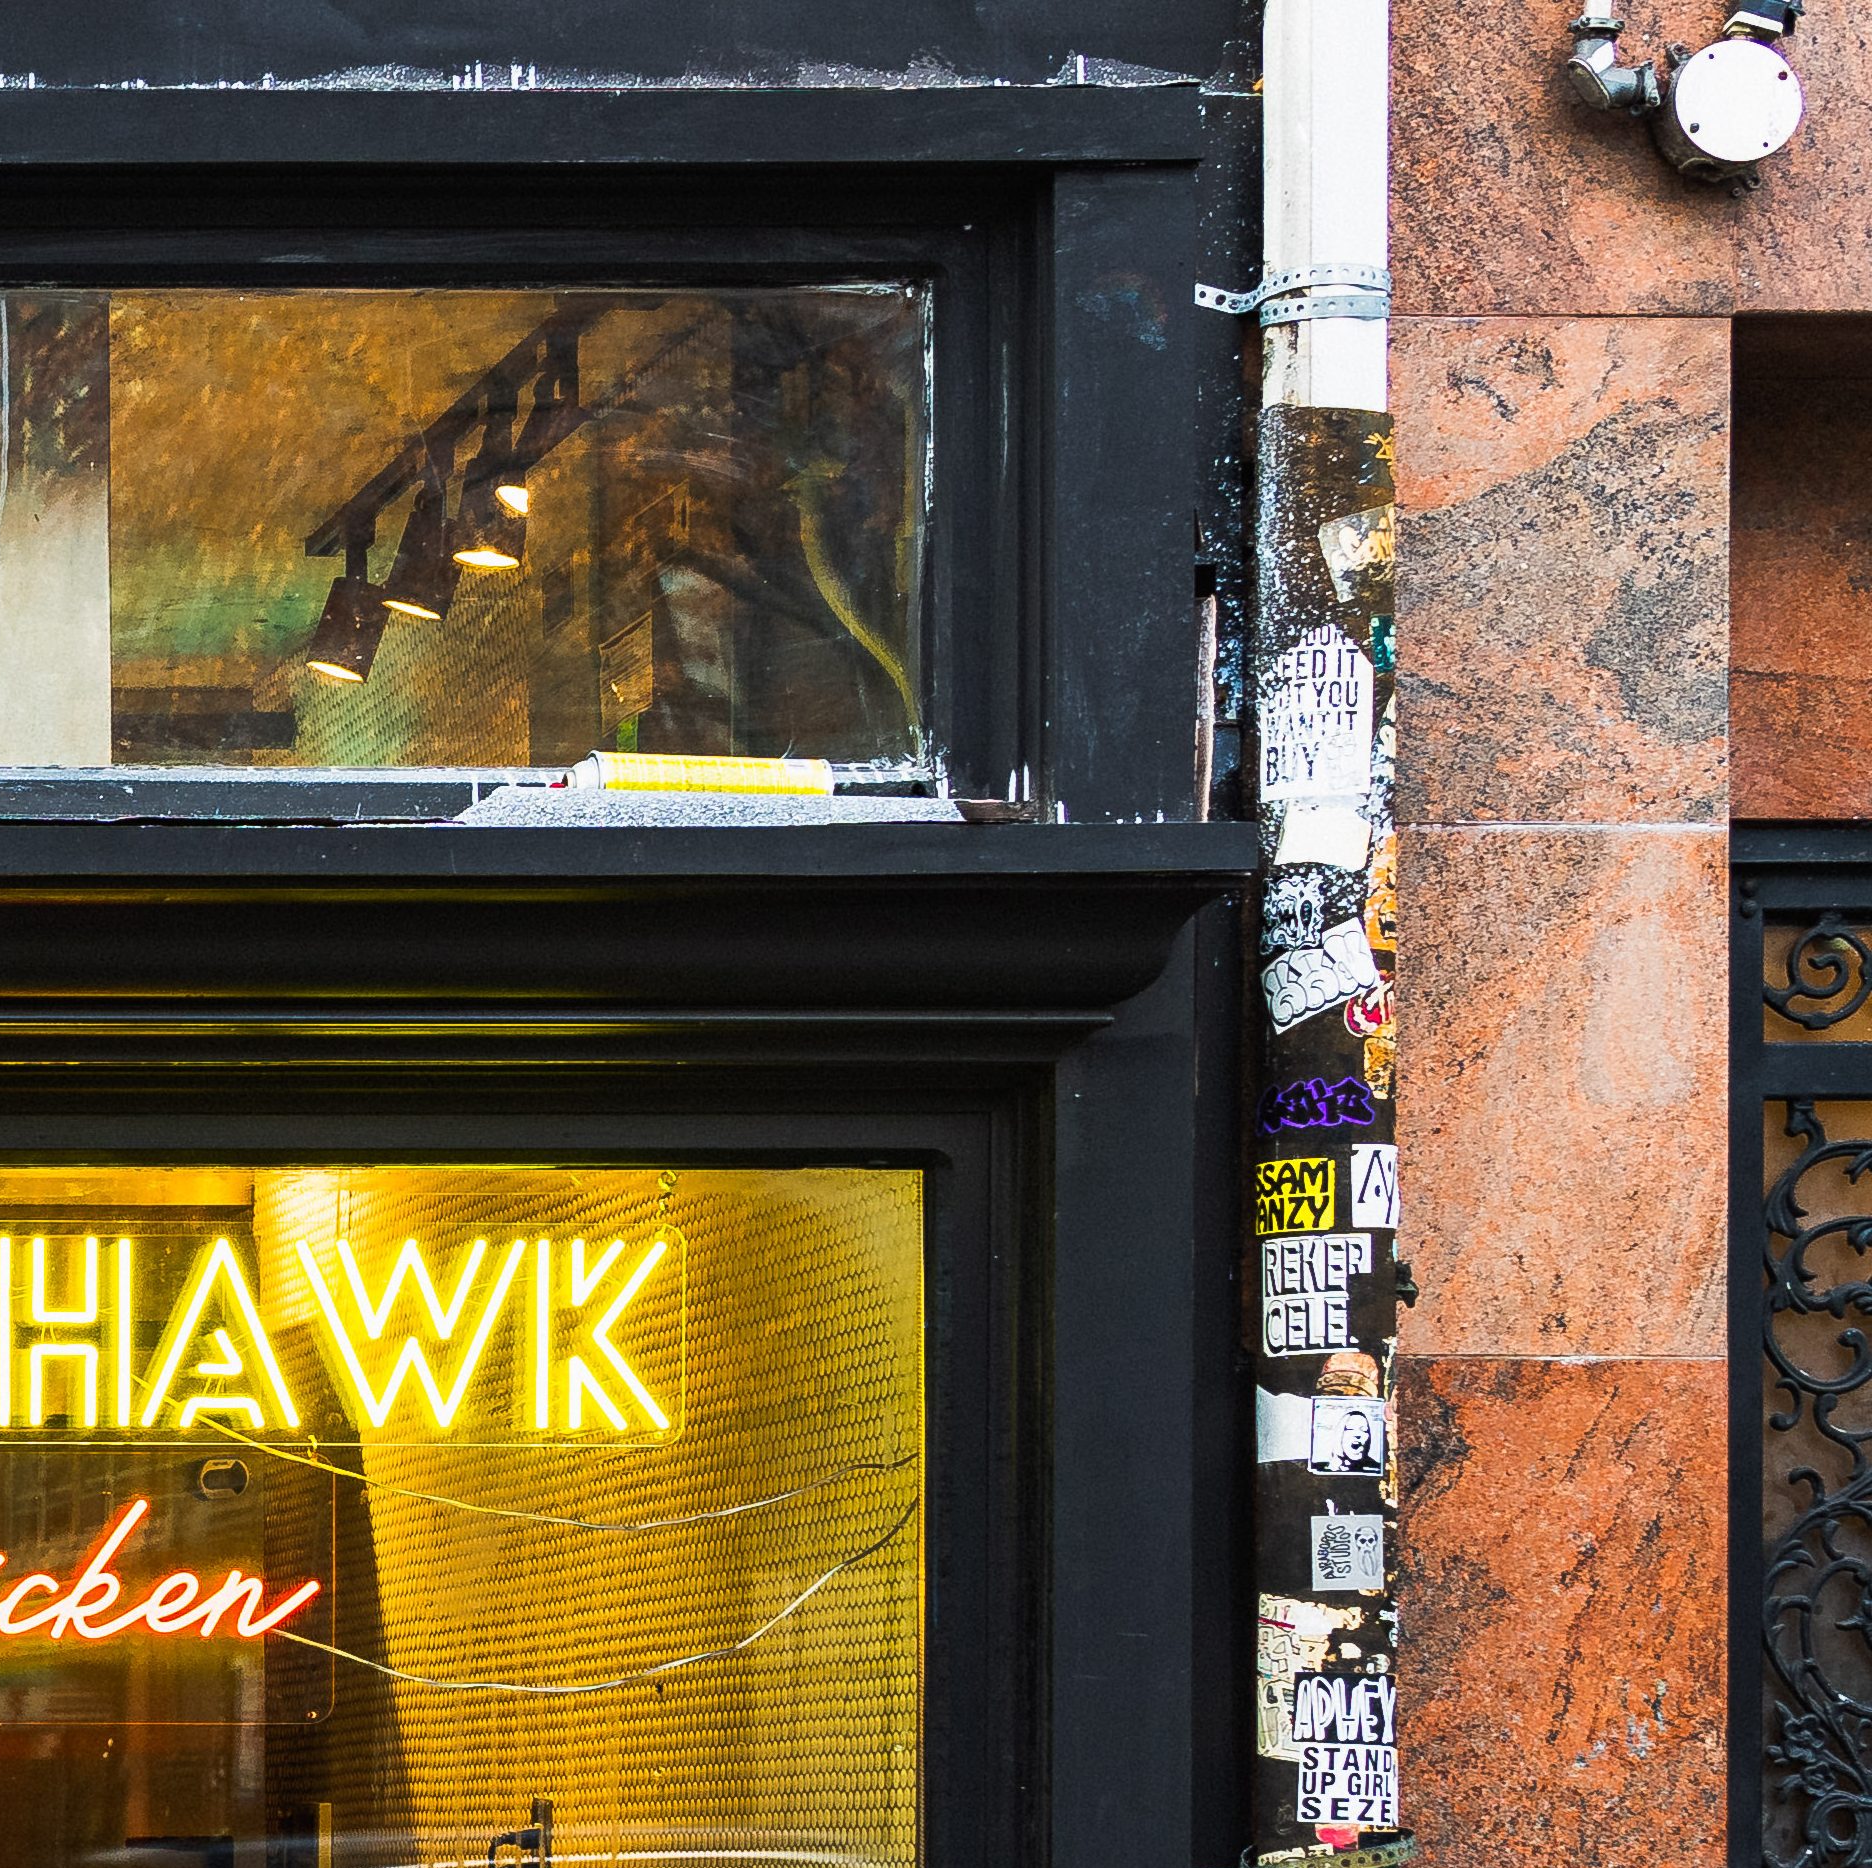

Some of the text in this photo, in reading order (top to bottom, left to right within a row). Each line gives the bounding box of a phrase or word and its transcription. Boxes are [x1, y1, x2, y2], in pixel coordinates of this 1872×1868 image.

[1337, 649, 1359, 678] IT
[1312, 681, 1358, 708] YOU
[1303, 1746, 1392, 1773] STAND
[1302, 1771, 1392, 1797] UP GIRL
